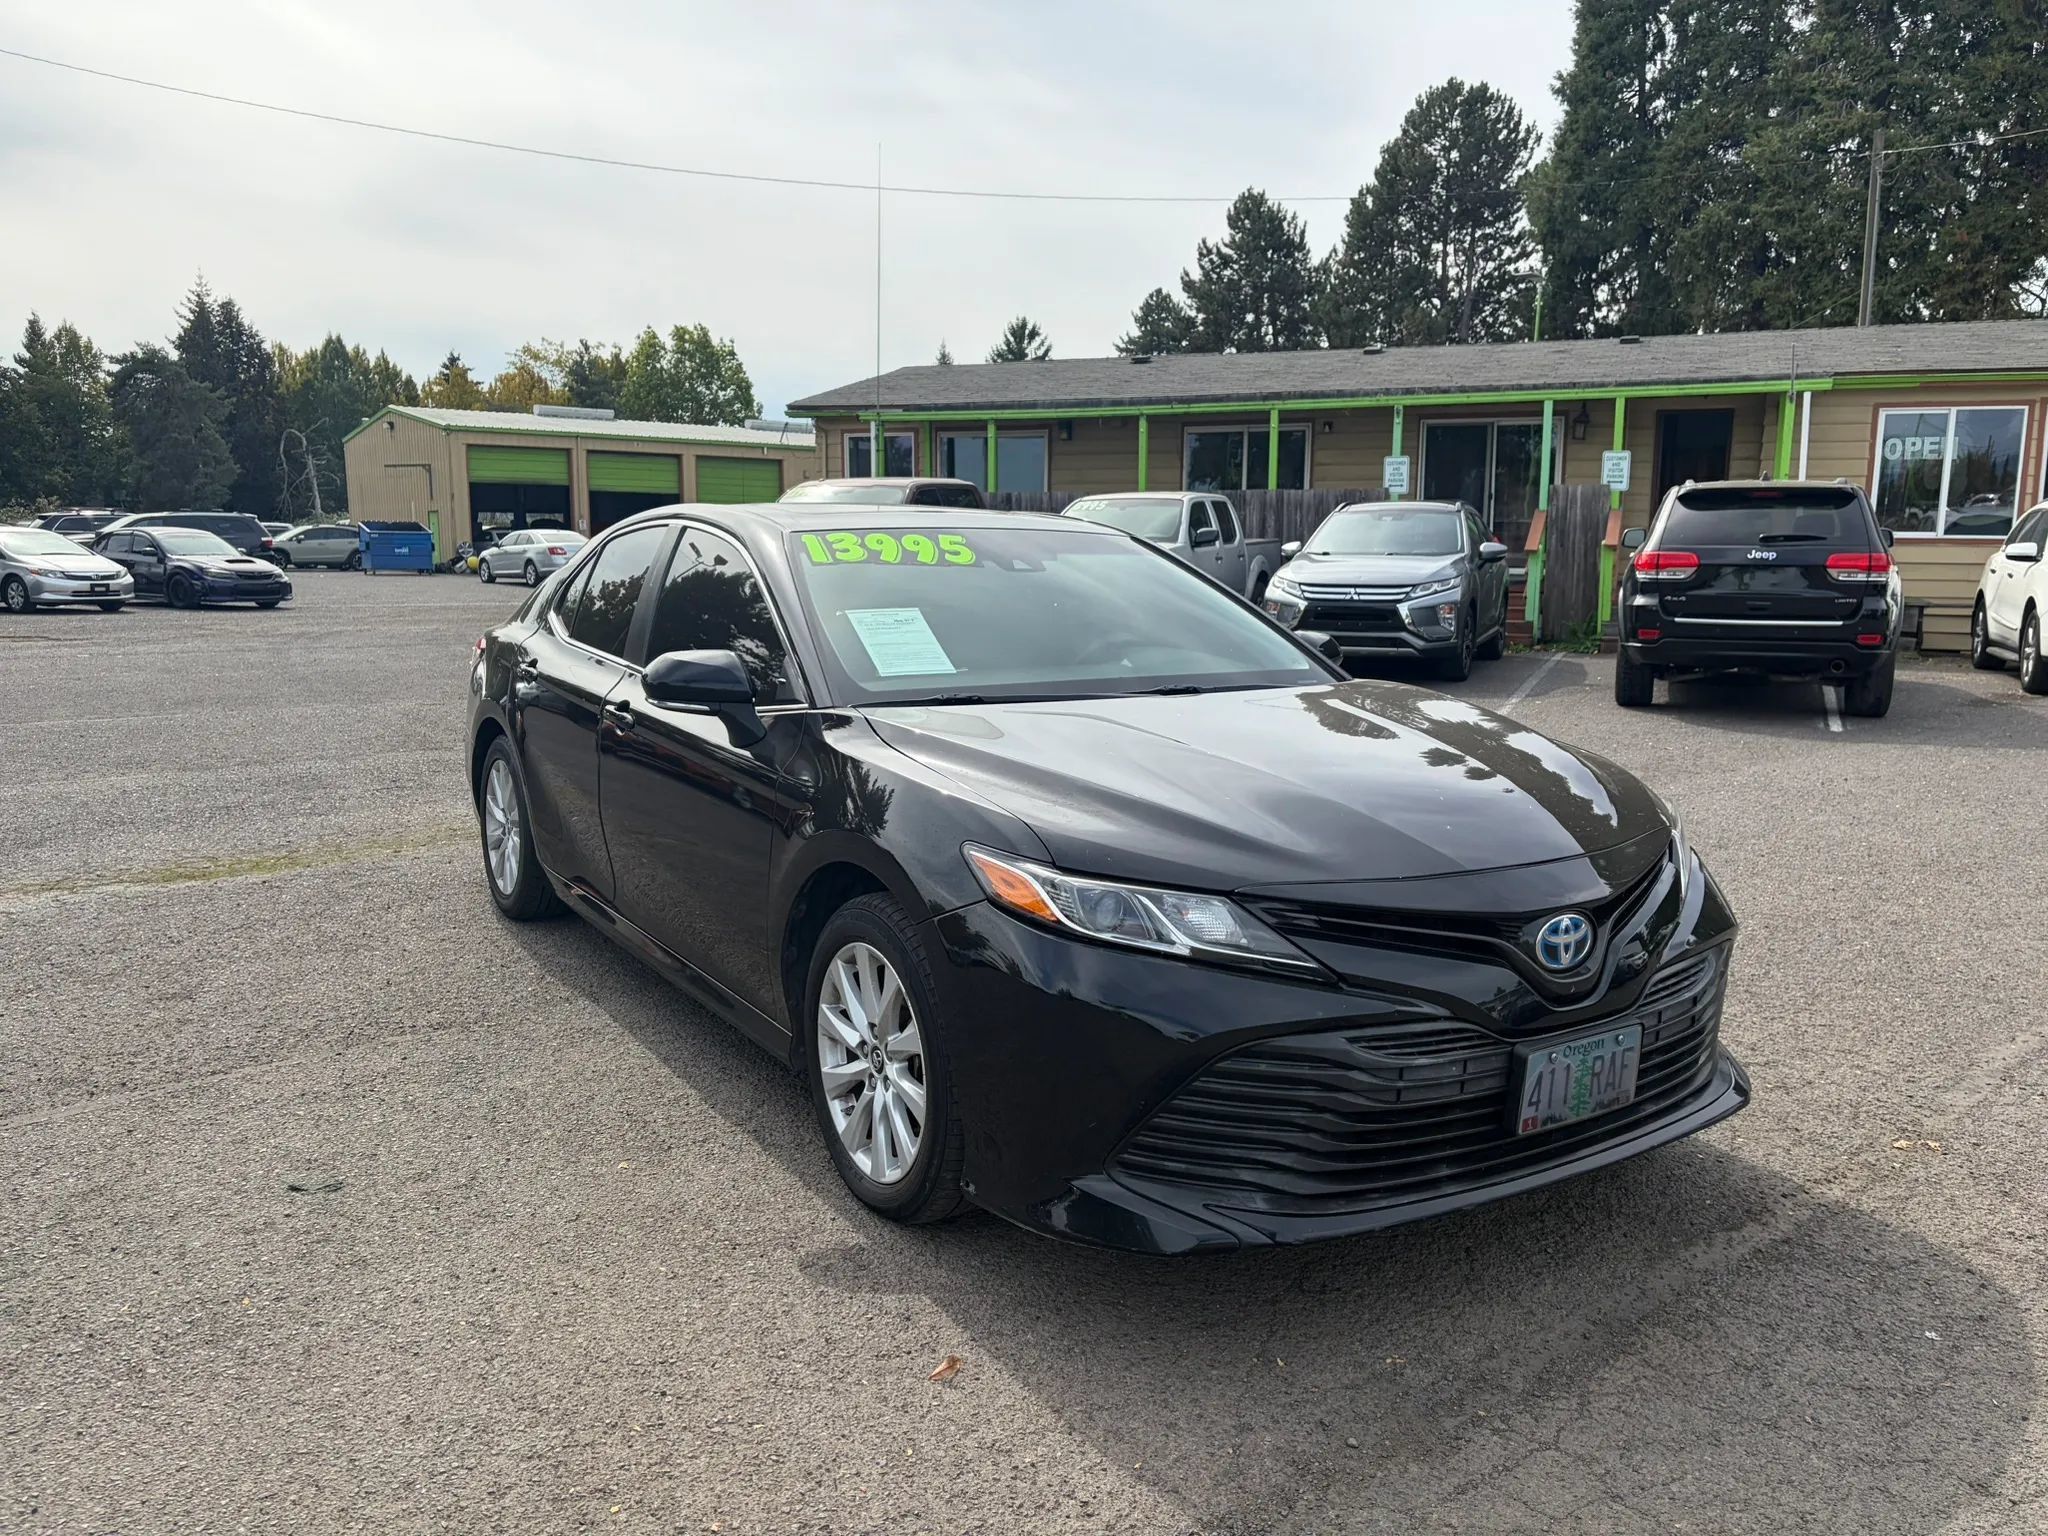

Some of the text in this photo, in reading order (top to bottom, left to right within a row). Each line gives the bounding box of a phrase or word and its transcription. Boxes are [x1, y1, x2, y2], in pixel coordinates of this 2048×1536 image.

[801, 532, 976, 565] 13995
[1747, 549, 1777, 561] Jeep
[1562, 1039, 1605, 1058] Oregon
[1527, 1062, 1572, 1113] 411
